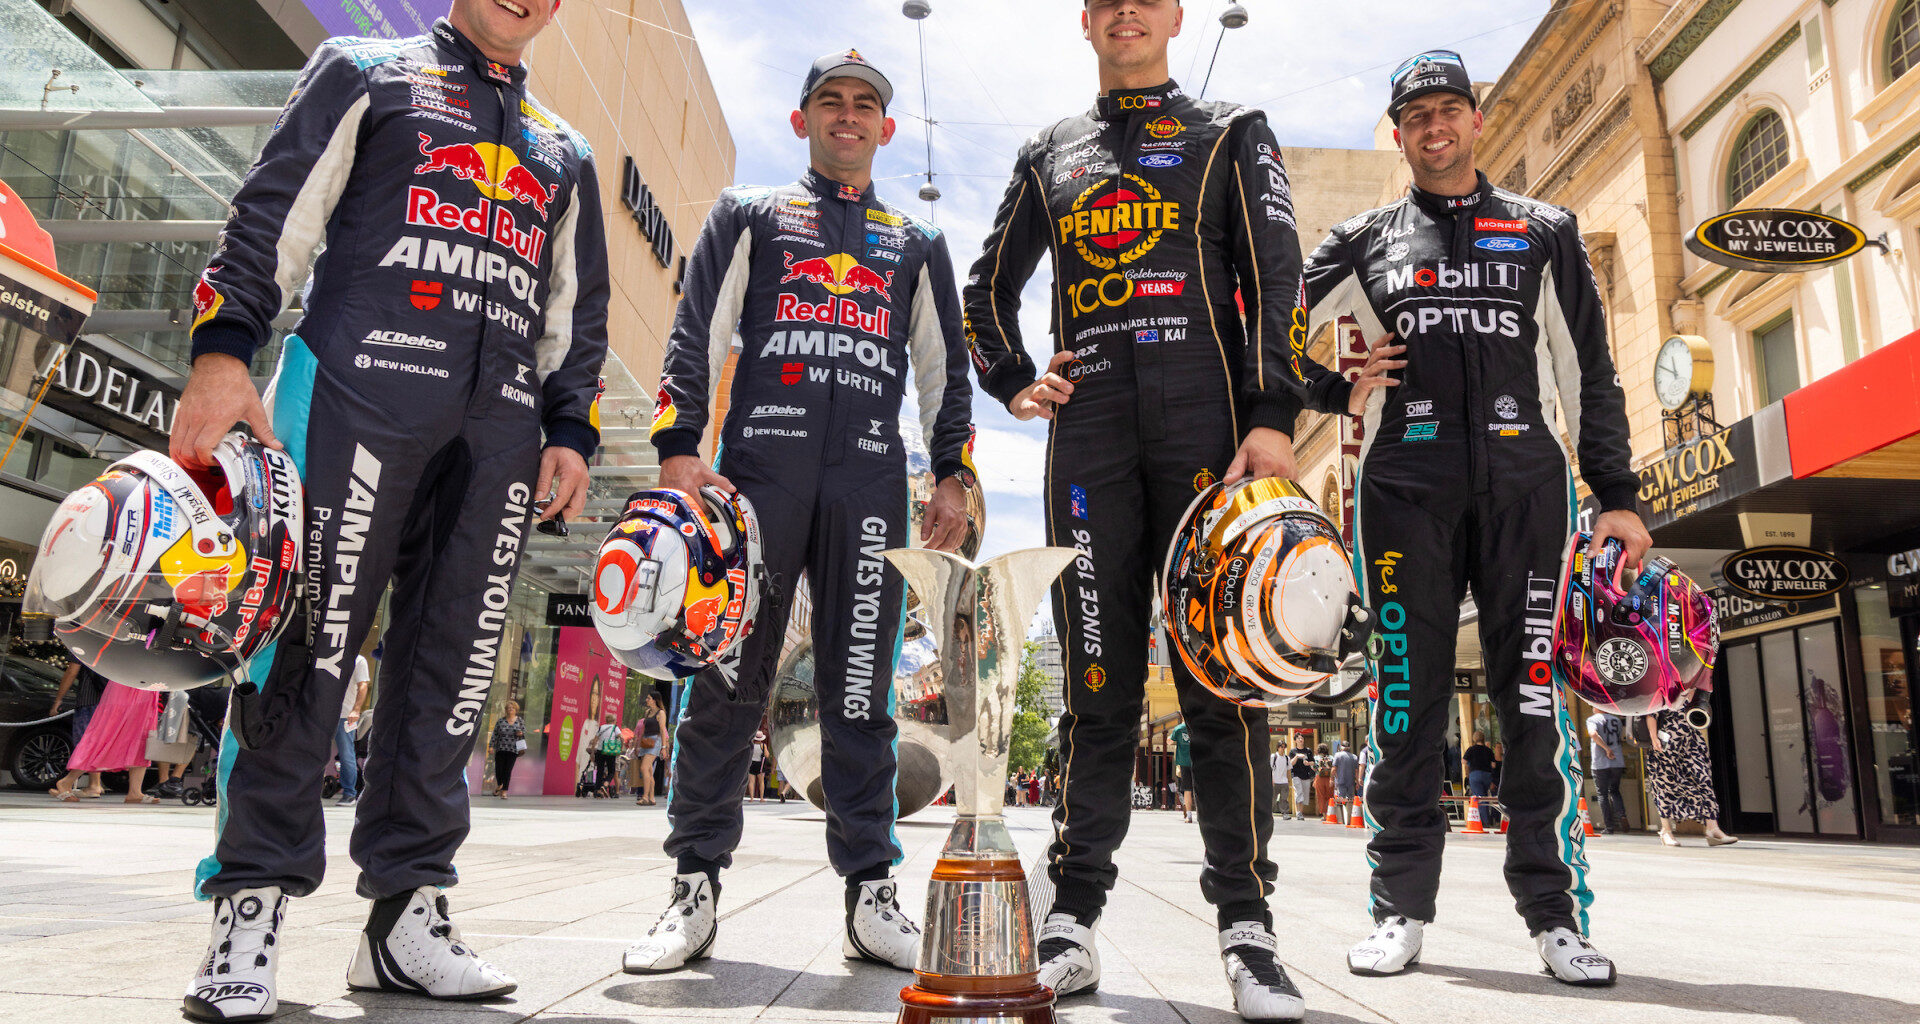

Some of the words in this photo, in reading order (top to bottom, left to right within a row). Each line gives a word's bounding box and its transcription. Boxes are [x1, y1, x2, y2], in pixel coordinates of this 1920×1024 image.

[1406, 76, 1448, 92] OPTUS
[411, 95, 472, 120] Partners
[1145, 122, 1187, 132] PENRITE
[1063, 144, 1102, 165] APEX
[1146, 154, 1175, 166] Ford
[1055, 162, 1104, 184] GROVE
[621, 155, 674, 269] DAVID
[1447, 194, 1472, 208] Mobil
[405, 185, 491, 237] Red
[492, 205, 547, 269] Bull
[778, 222, 820, 238] Partners
[1058, 202, 1180, 245] PENRITE
[1381, 222, 1416, 244] yes
[1478, 221, 1523, 230] MORRIS
[870, 249, 901, 263] JGI
[1487, 238, 1518, 249] Ford
[1728, 240, 1749, 251] MY
[1753, 240, 1836, 254] JEWELLER
[378, 235, 541, 316] AMPOL
[1124, 268, 1188, 282] Celebrating
[1140, 283, 1174, 294] YEARS
[1386, 262, 1479, 295] Mobil
[1067, 271, 1134, 319] 100
[775, 293, 837, 325] Red
[838, 297, 891, 340] Bull
[1075, 322, 1119, 342] AUSTRALIAN
[1150, 318, 1156, 326] &
[1157, 316, 1188, 326] OWNED
[1396, 307, 1521, 340] OPTUS
[362, 329, 447, 351] ACDelco
[1164, 328, 1187, 341] KAI
[759, 330, 897, 377] AMPOL
[374, 359, 399, 369] NEW
[400, 363, 449, 378] HOLLAND
[1069, 358, 1111, 378] airtouch
[501, 383, 535, 409] BROWN
[1406, 403, 1433, 415] OMP
[750, 405, 807, 417] ACDelco
[754, 428, 770, 436] NEW
[771, 429, 808, 438] HOLLAND
[1406, 423, 1437, 437] 25
[1488, 422, 1530, 432] SUPERCHEAP
[857, 437, 889, 454] FEENEY
[266, 453, 290, 519] KMC
[1652, 495, 1669, 515] MY
[1671, 475, 1720, 511] JEWELLER
[176, 485, 210, 525] Blygold
[492, 481, 531, 567] GIVES
[1765, 530, 1779, 538] EST.
[281, 540, 291, 569] ROSSI
[308, 505, 333, 602] Premium
[856, 516, 888, 587] GIVES
[1071, 529, 1096, 580] 1926
[243, 555, 274, 606] Bull
[315, 476, 376, 680] AMPLIFY
[1223, 558, 1245, 609] airtouch
[1375, 550, 1403, 594] yes
[1748, 580, 1768, 590] MY
[1772, 580, 1827, 591] JEWELLER
[477, 571, 513, 631] YOU
[724, 567, 746, 619] Bull
[1218, 580, 1227, 602] Smart
[850, 588, 881, 639] YOU
[1080, 585, 1103, 658] SINCE
[1179, 587, 1190, 643] boost
[1217, 602, 1225, 613] AC
[1246, 594, 1257, 632] GROVE
[1668, 603, 1680, 638] Mobil
[1743, 614, 1759, 626] HAIR
[1759, 611, 1783, 624] SALON
[1380, 601, 1410, 735] OPTUS
[1519, 617, 1552, 717] Mobil
[1600, 647, 1611, 674] GUYS
[1619, 642, 1645, 682] CHEMICAL
[446, 637, 499, 737] WINGS
[843, 644, 877, 721] WINGS
[1090, 662, 1100, 692] PENRITE
[195, 984, 264, 1001] OMP
